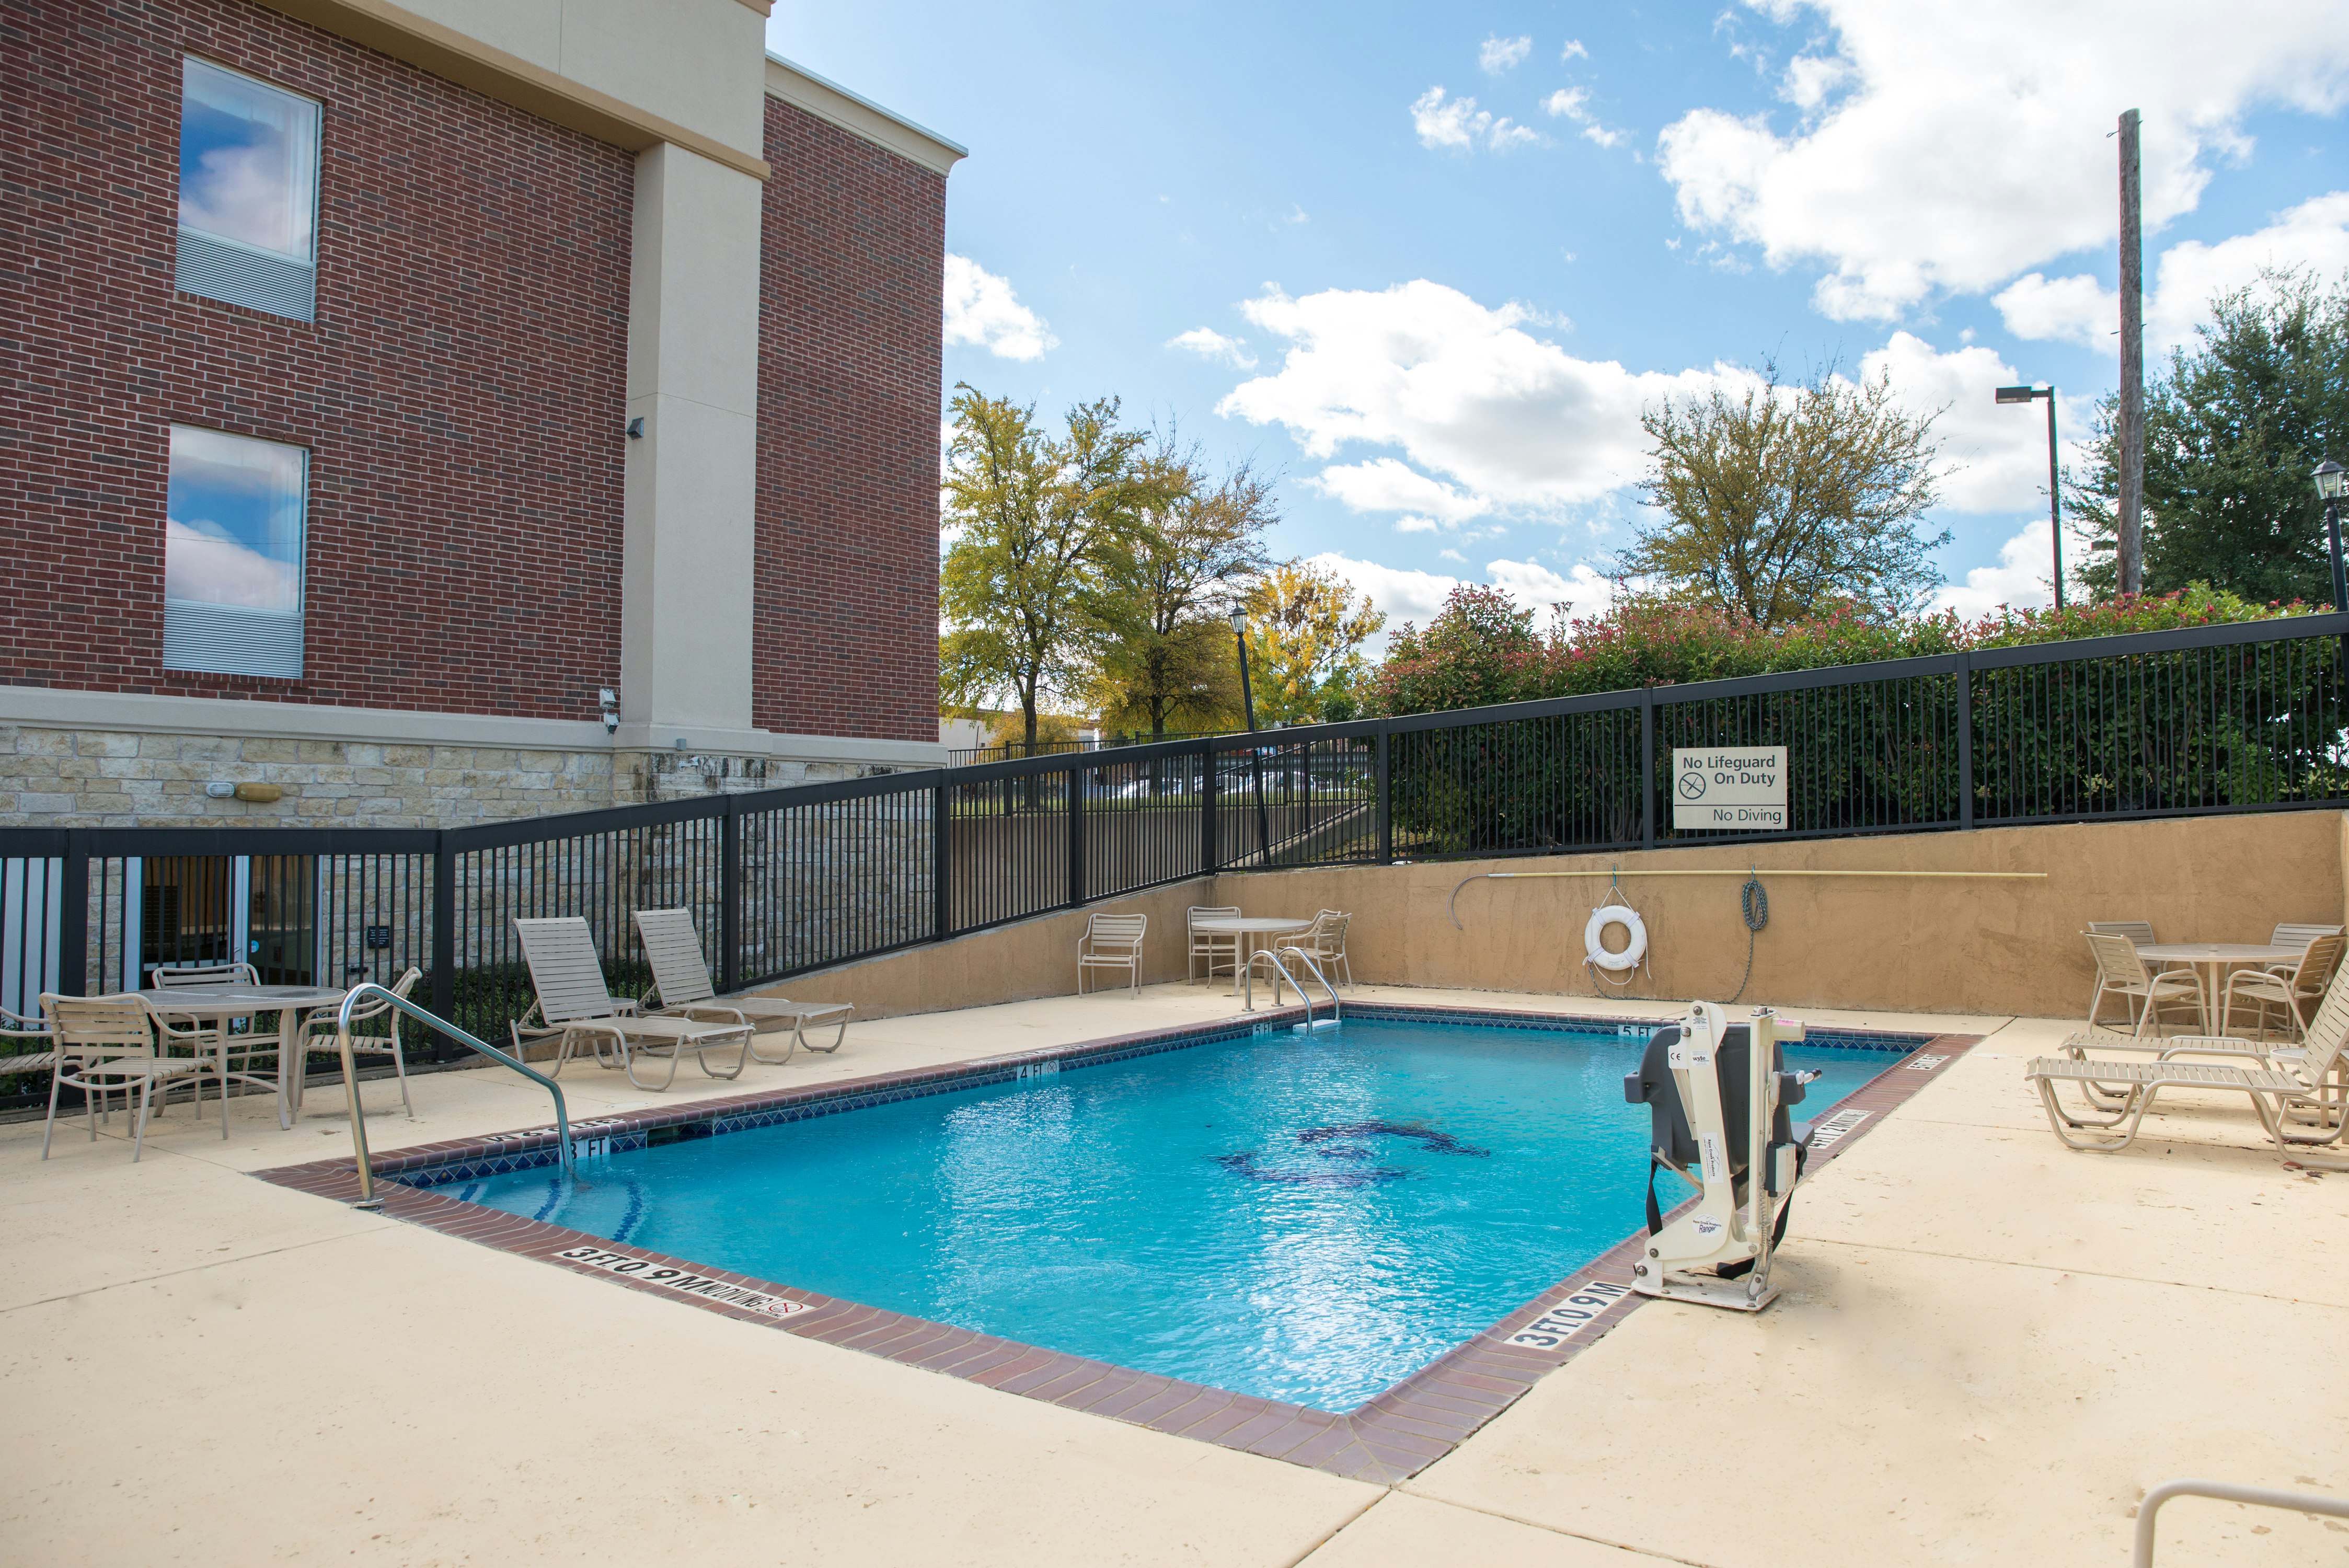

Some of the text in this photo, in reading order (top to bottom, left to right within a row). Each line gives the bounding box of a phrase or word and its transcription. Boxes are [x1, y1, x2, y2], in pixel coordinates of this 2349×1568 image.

[1683, 755, 1775, 771] No Lifeguard
[1714, 773, 1776, 787] On Duty
[1713, 809, 1781, 824] No Diving
[1264, 1022, 1270, 1033] FT
[1623, 1025, 1651, 1036] 5 FT
[1020, 1063, 1043, 1078] 4 FT
[589, 1137, 605, 1157] FT
[1699, 1225, 1716, 1233] Ranger
[563, 1248, 599, 1258] 3
[664, 1275, 716, 1290] M
[1514, 1333, 1559, 1346] 3
[1583, 1282, 1632, 1297] M
